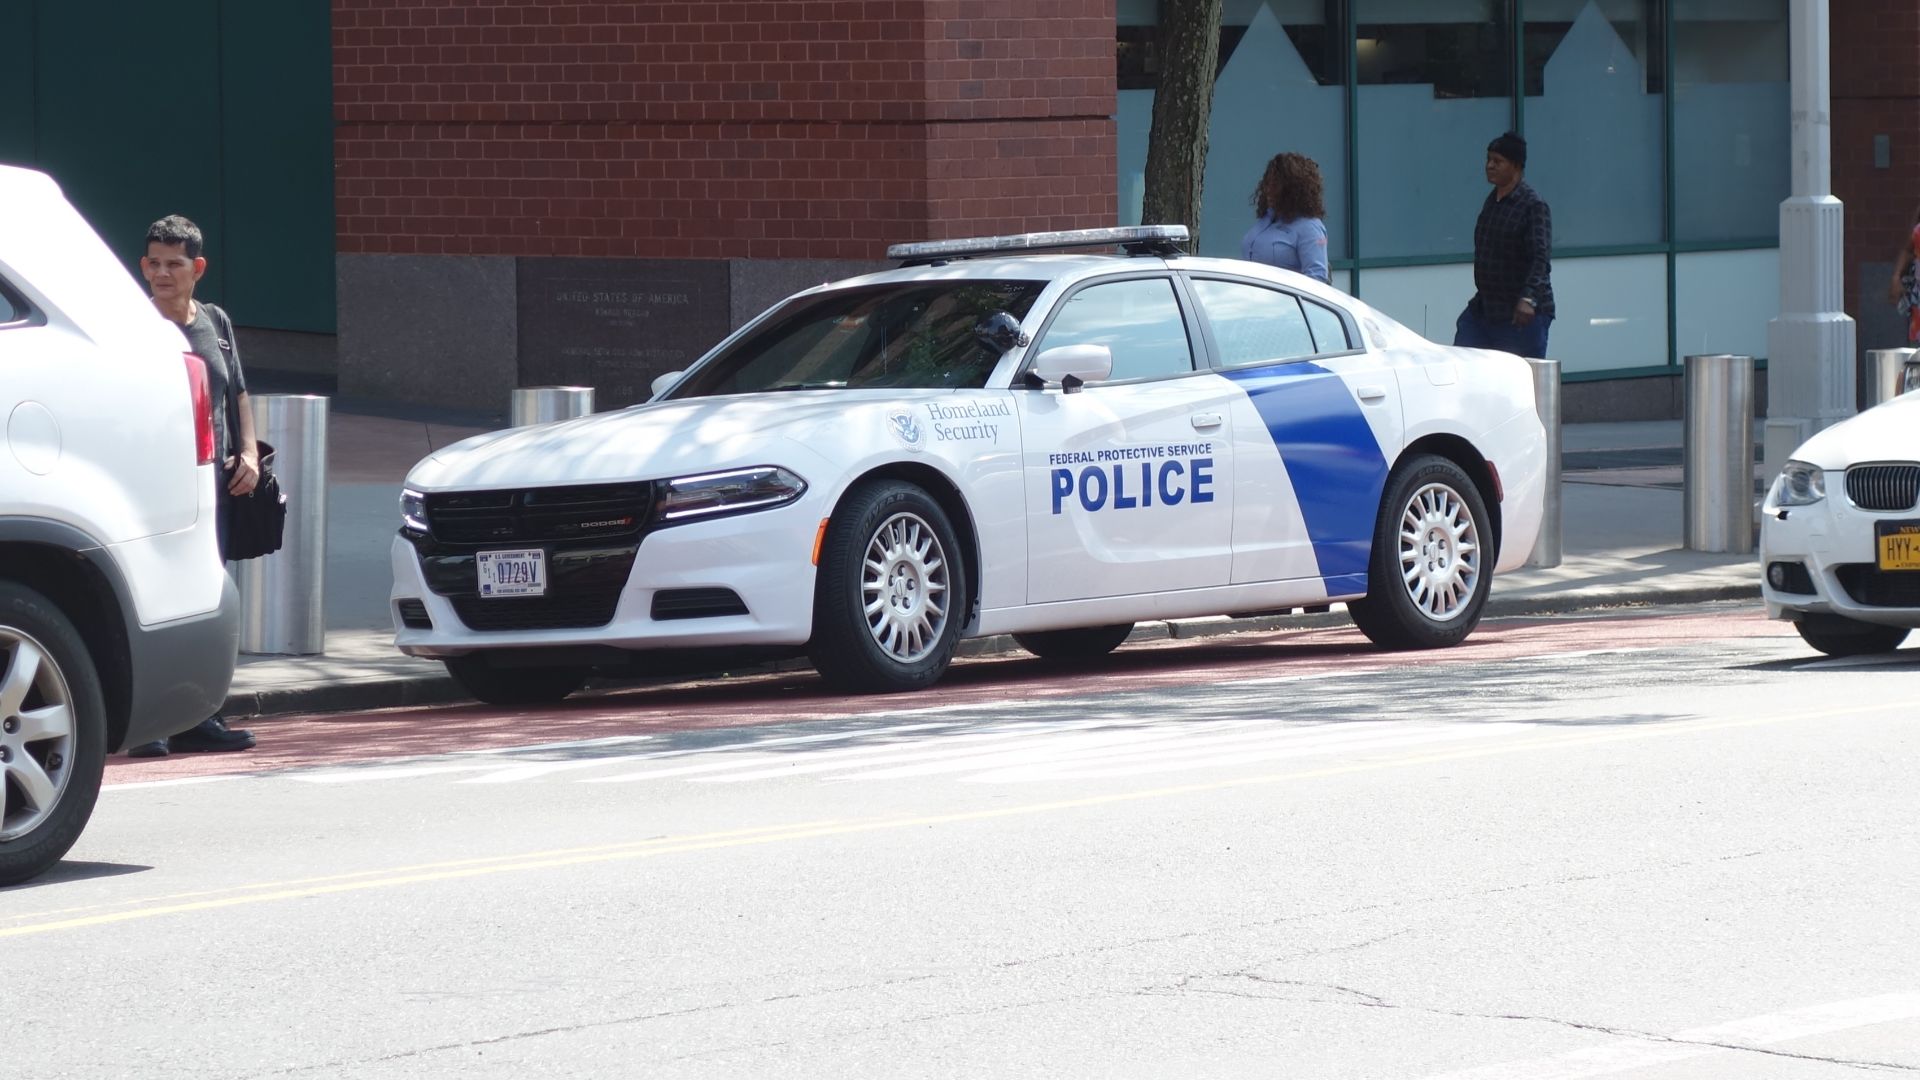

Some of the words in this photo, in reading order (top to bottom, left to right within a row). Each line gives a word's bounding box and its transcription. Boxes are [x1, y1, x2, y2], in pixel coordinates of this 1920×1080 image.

[593, 292, 628, 303] STATES
[632, 293, 645, 303] OF
[648, 293, 689, 304] AMERICA
[926, 399, 1011, 420] Homeland
[934, 420, 998, 445] Security
[1049, 453, 1095, 465] FEDERAL
[1098, 447, 1164, 461] PROTECTIVE
[1168, 443, 1212, 456] SERVICE
[1051, 458, 1214, 515] POLICE
[581, 519, 625, 528] DODGE
[497, 561, 537, 584] 0729V
